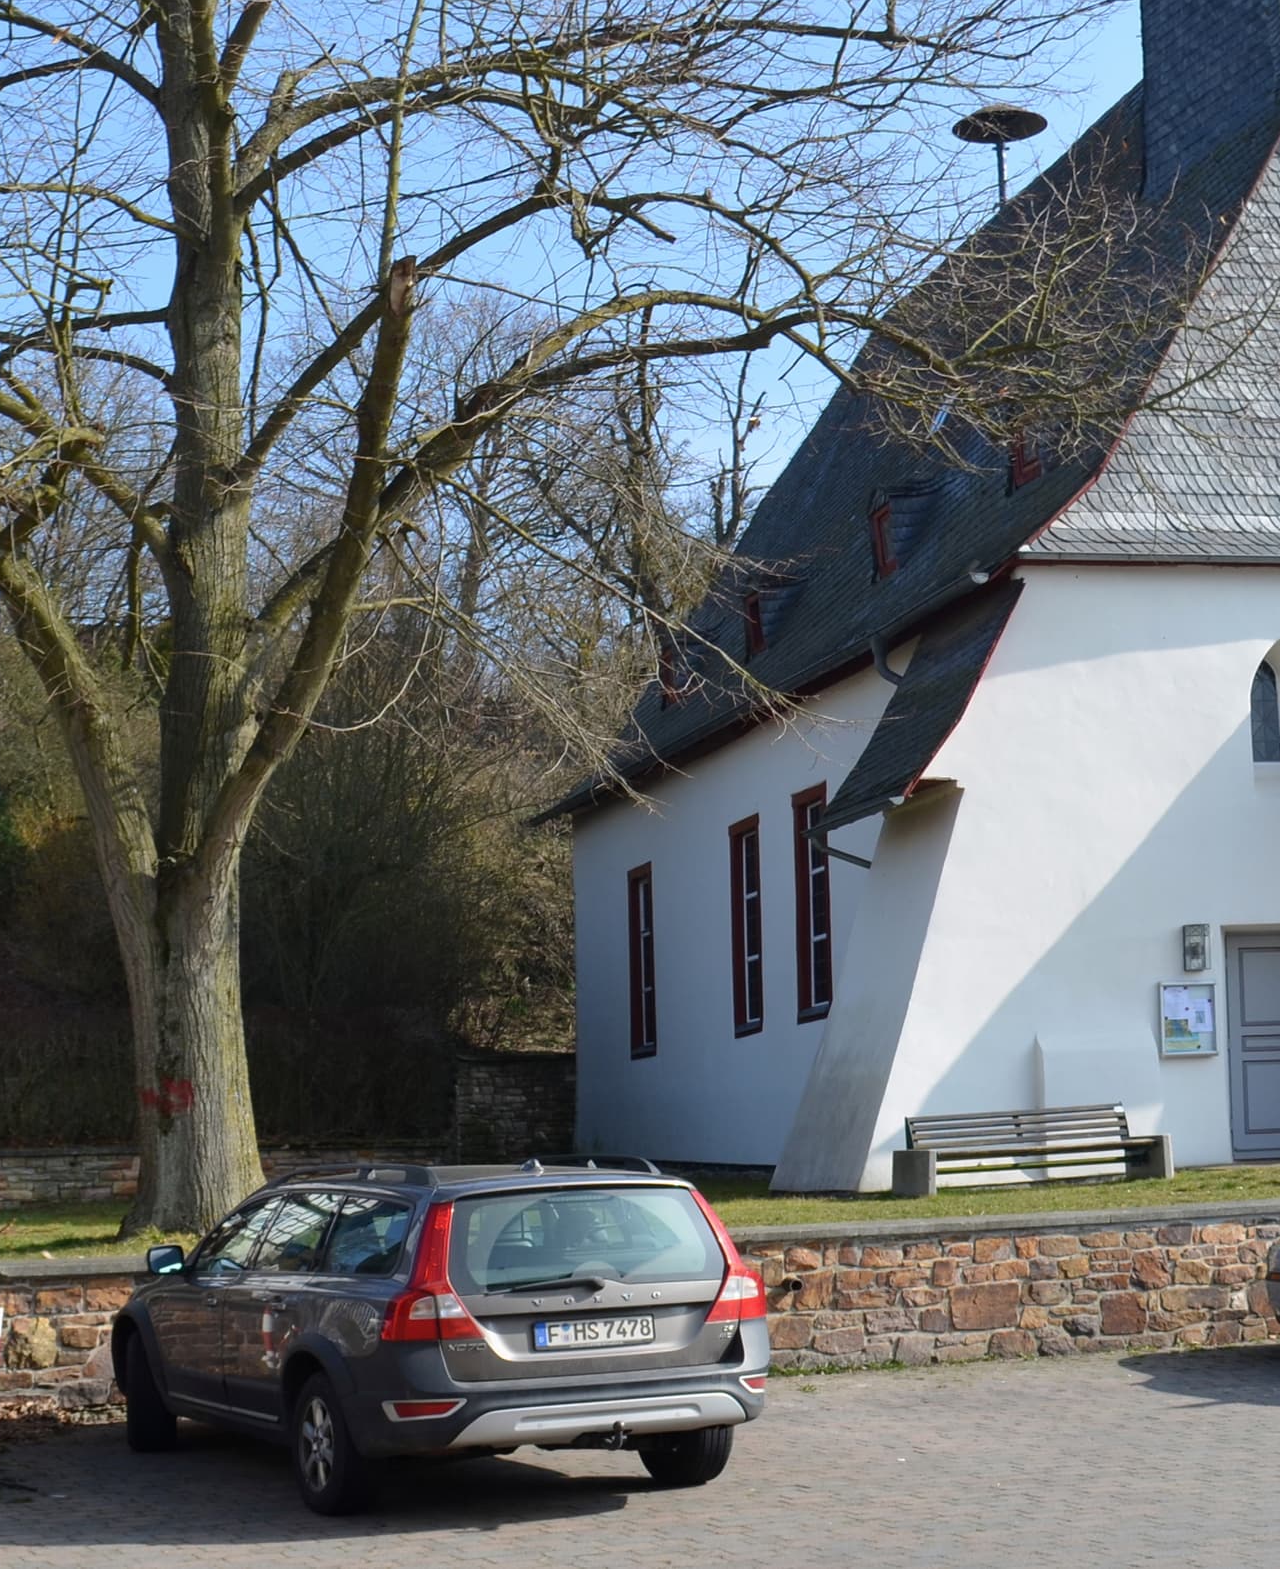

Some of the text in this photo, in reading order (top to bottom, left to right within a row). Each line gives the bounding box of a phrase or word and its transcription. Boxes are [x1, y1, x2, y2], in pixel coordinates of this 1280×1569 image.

[531, 1291, 661, 1307] VOLVO
[548, 1318, 651, 1343] F HS 7478
